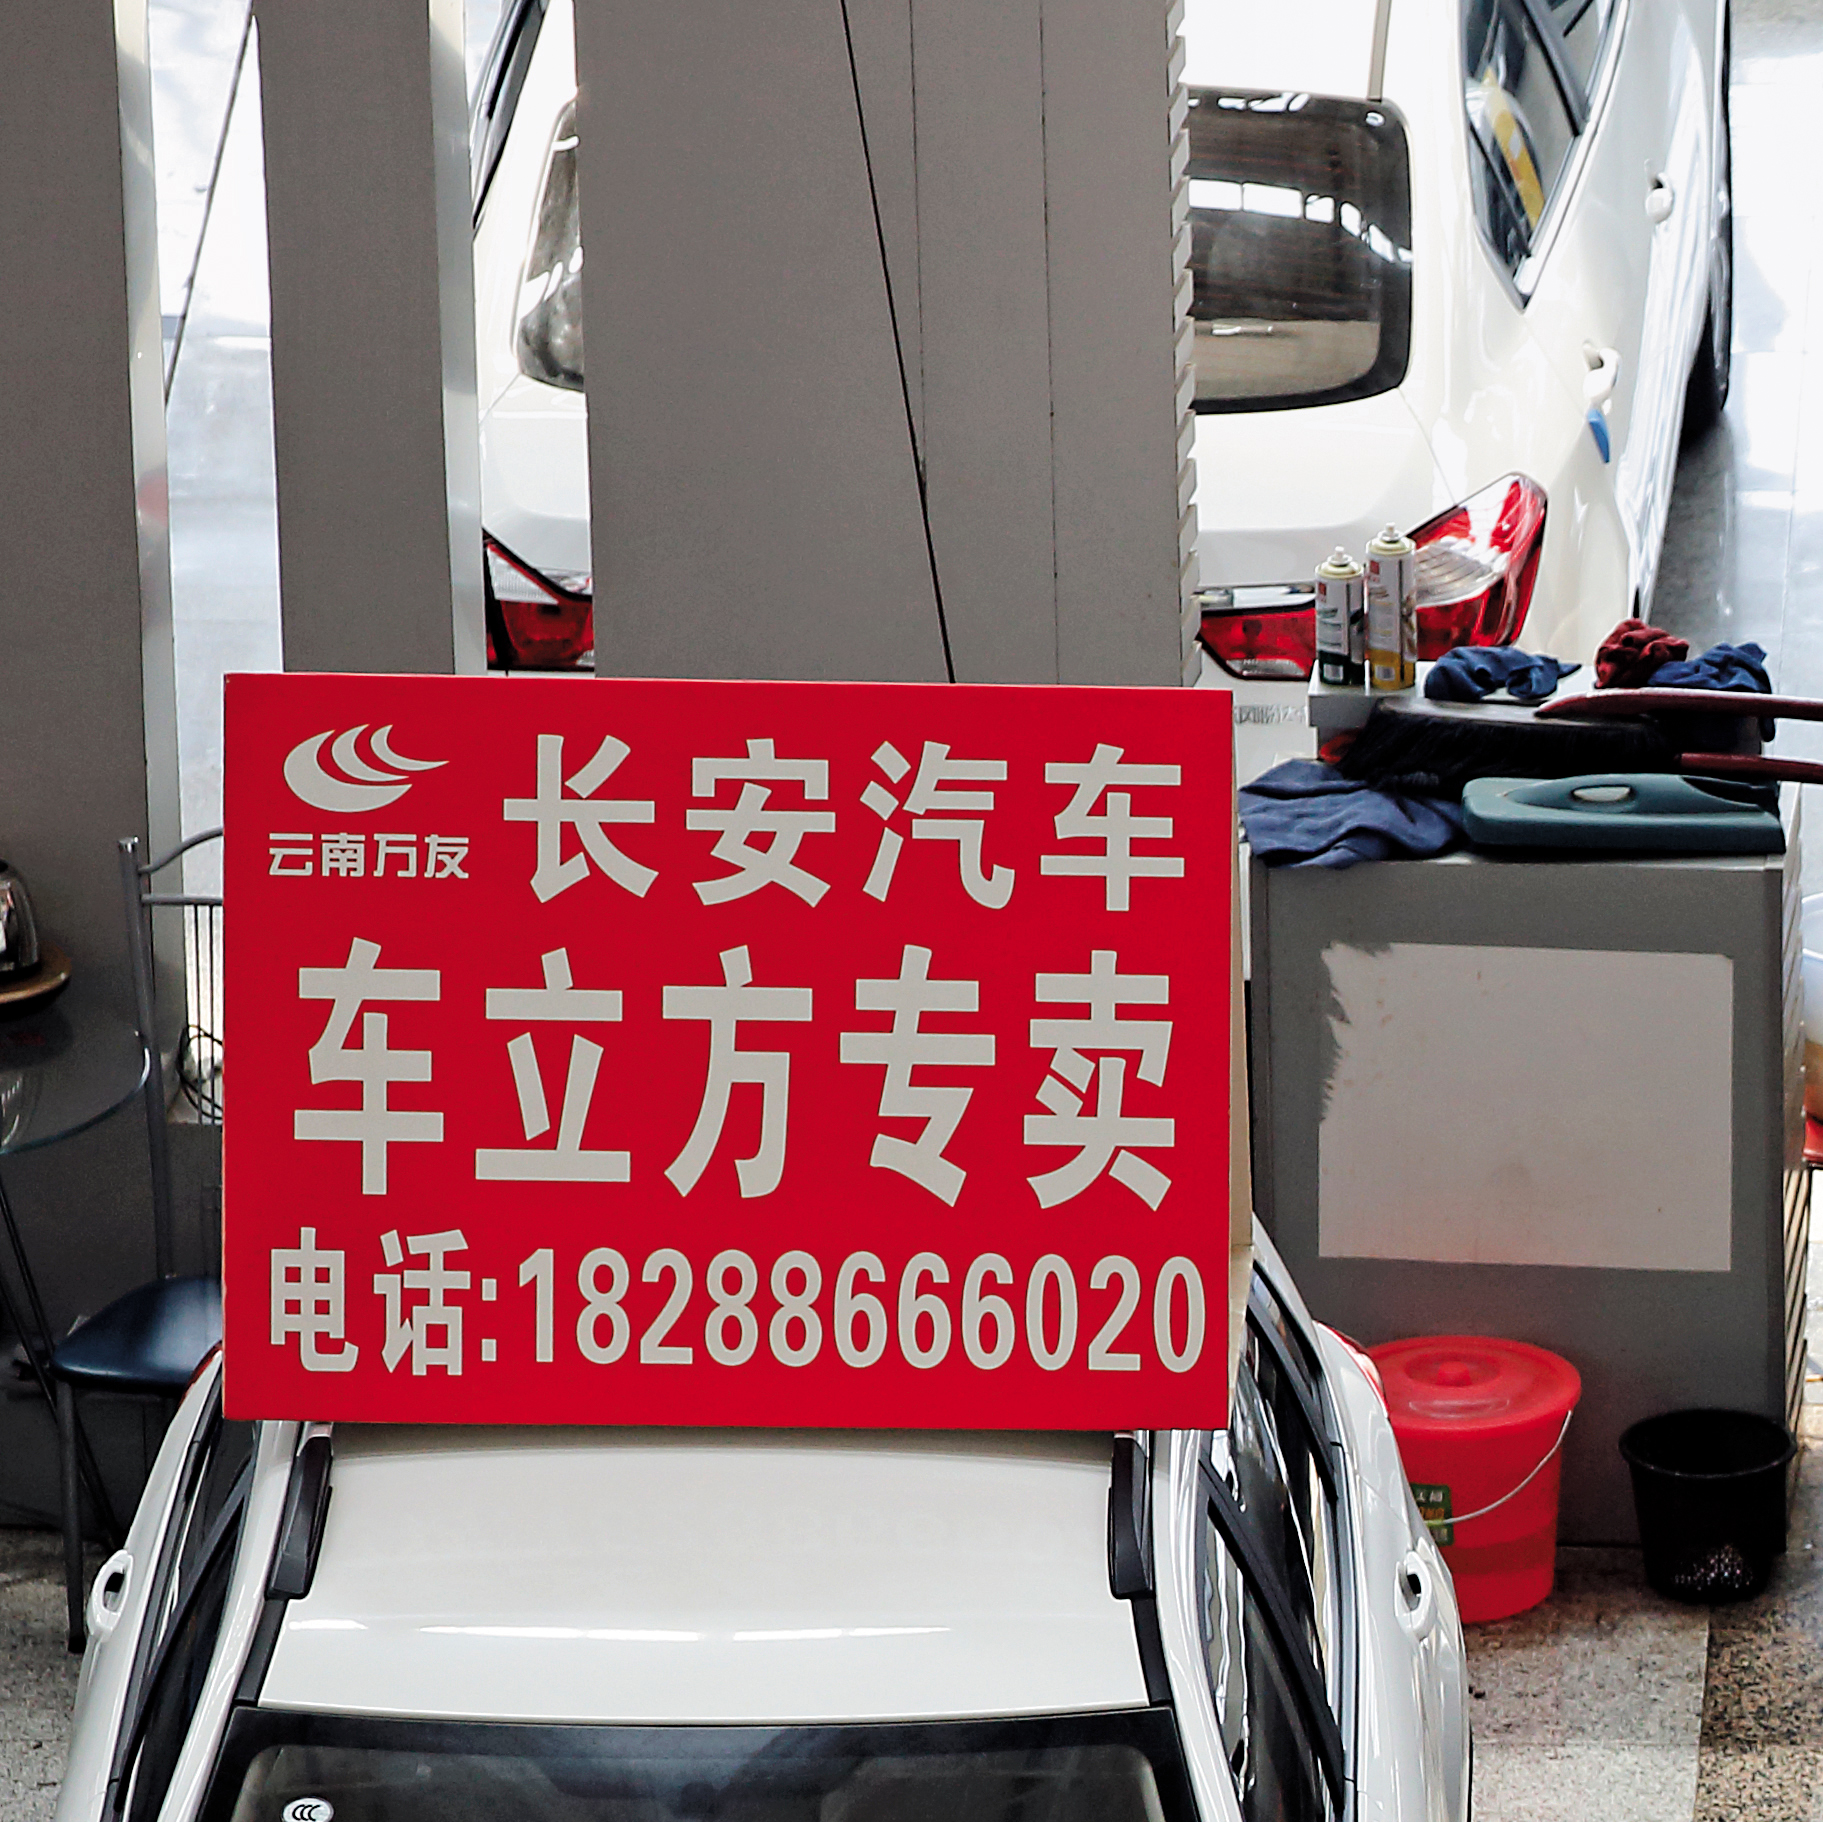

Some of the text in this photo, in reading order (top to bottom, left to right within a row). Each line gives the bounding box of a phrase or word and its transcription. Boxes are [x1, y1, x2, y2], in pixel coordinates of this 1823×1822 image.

[270, 833, 469, 878] 云南万友
[504, 734, 1184, 911] 长安汽车
[294, 938, 1174, 1210] 车立方专卖
